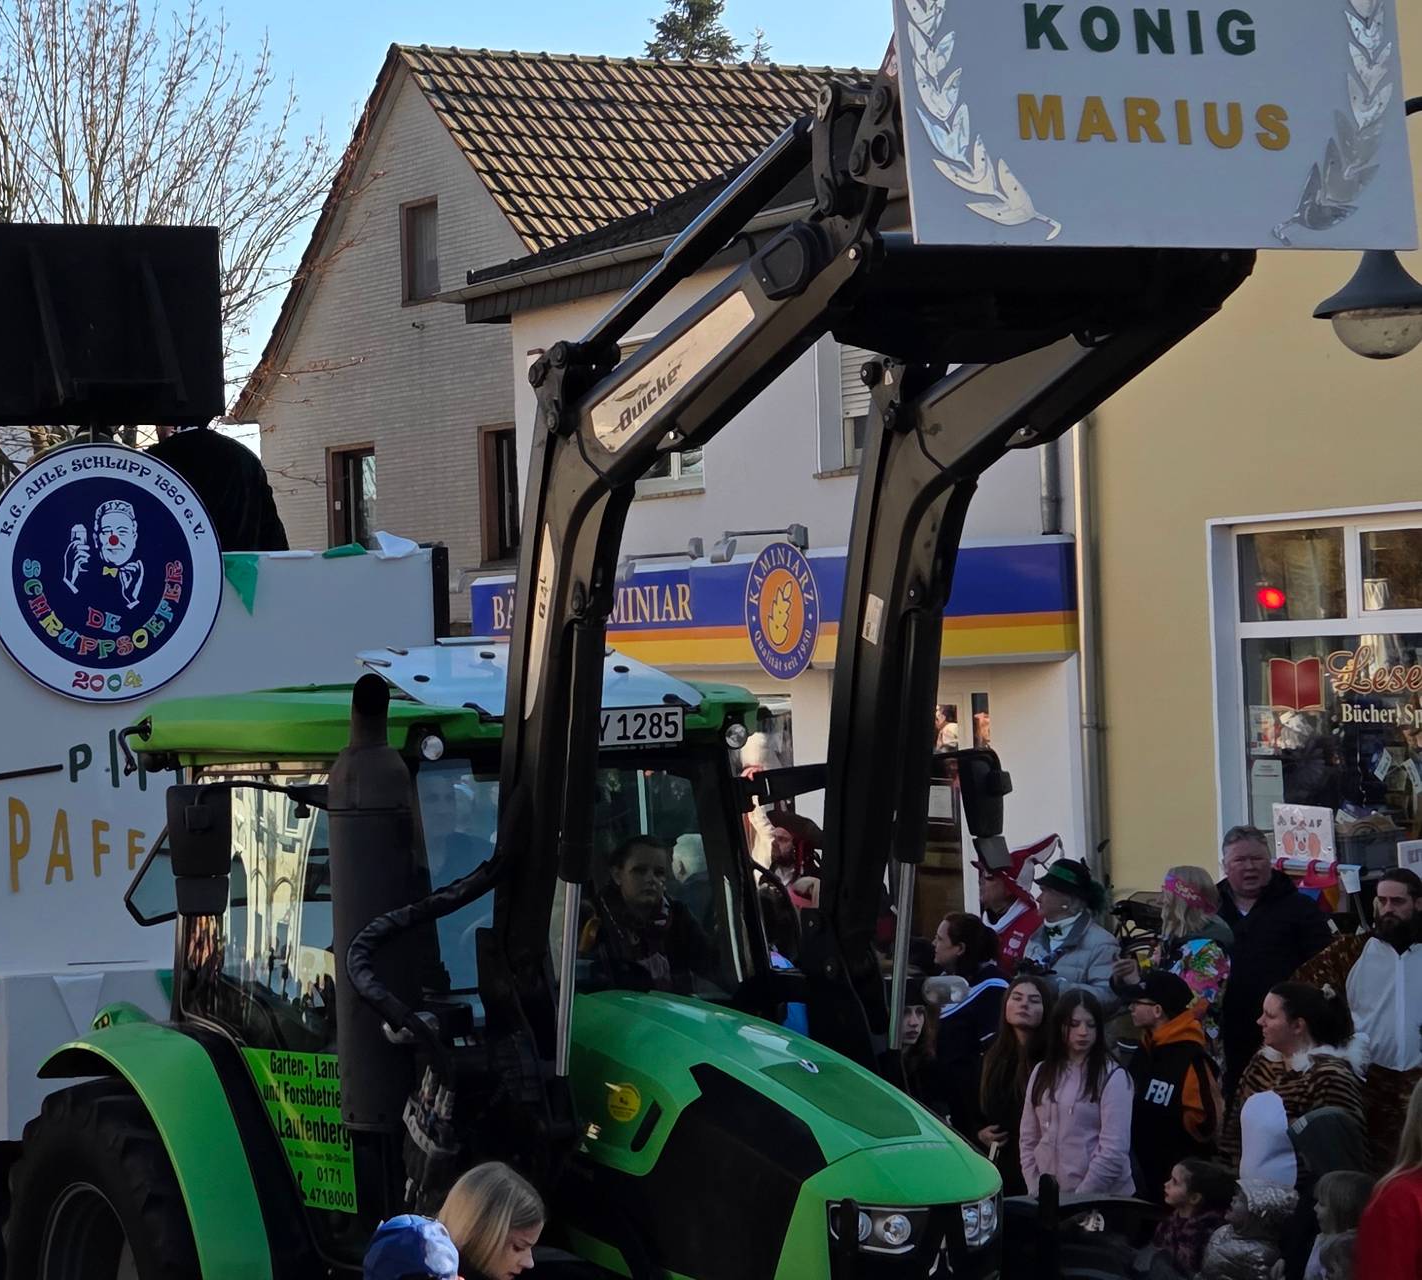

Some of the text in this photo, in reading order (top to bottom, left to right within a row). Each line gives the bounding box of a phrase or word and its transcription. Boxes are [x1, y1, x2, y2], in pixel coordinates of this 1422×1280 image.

[1017, 93, 1290, 151] MARIUS
[611, 363, 682, 433] Quicke
[25, 464, 67, 500] AHLE
[71, 455, 152, 478] SCHLUPP
[749, 547, 814, 605] KAMINIARZ
[22, 558, 184, 659] SCHRUPPSOEFER
[86, 607, 122, 633] DE
[607, 583, 693, 624] MINIAR
[754, 629, 812, 672] Qualität seit 1950
[72, 669, 143, 692] 2004
[617, 712, 679, 740] 1285
[263, 1081, 341, 1108] und Forstbetrie
[1144, 1079, 1174, 1106] FBI
[278, 1110, 351, 1151] Laufenberg
[317, 1167, 341, 1184] 0171
[309, 1186, 354, 1207] 4718000
